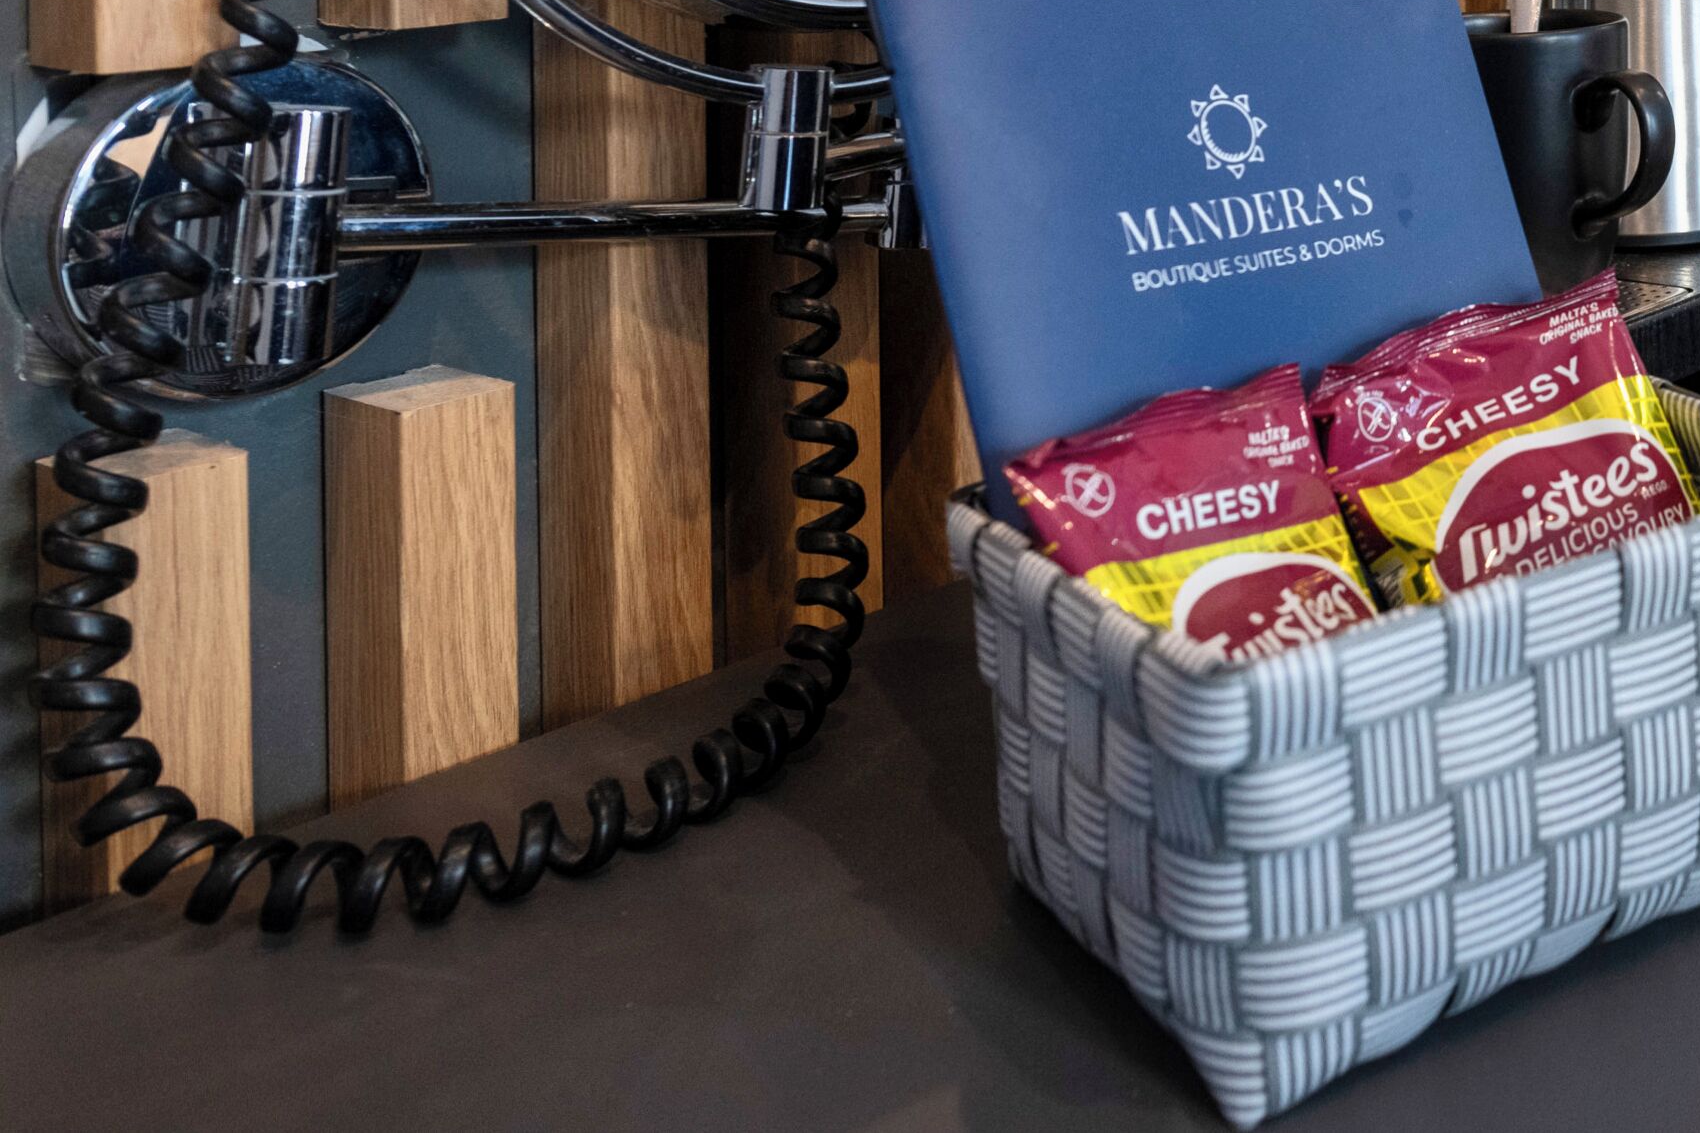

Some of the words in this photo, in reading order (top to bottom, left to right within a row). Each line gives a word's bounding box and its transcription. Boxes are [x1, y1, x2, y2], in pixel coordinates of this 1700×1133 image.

[1117, 175, 1374, 255] MANDERA'S
[1131, 257, 1233, 292] BOUTIQUE
[1234, 246, 1297, 274] SUITES
[1299, 244, 1313, 262] &
[1314, 229, 1385, 259] DORMS
[1539, 318, 1586, 345] ORIGINAL
[1549, 302, 1599, 327] MALTA'S
[1569, 323, 1602, 344] SNACK
[1416, 356, 1580, 451] CHEESY
[1136, 479, 1280, 540] CHEESY
[1459, 442, 1658, 585] Twistees
[1515, 502, 1638, 577] DELICIOUS
